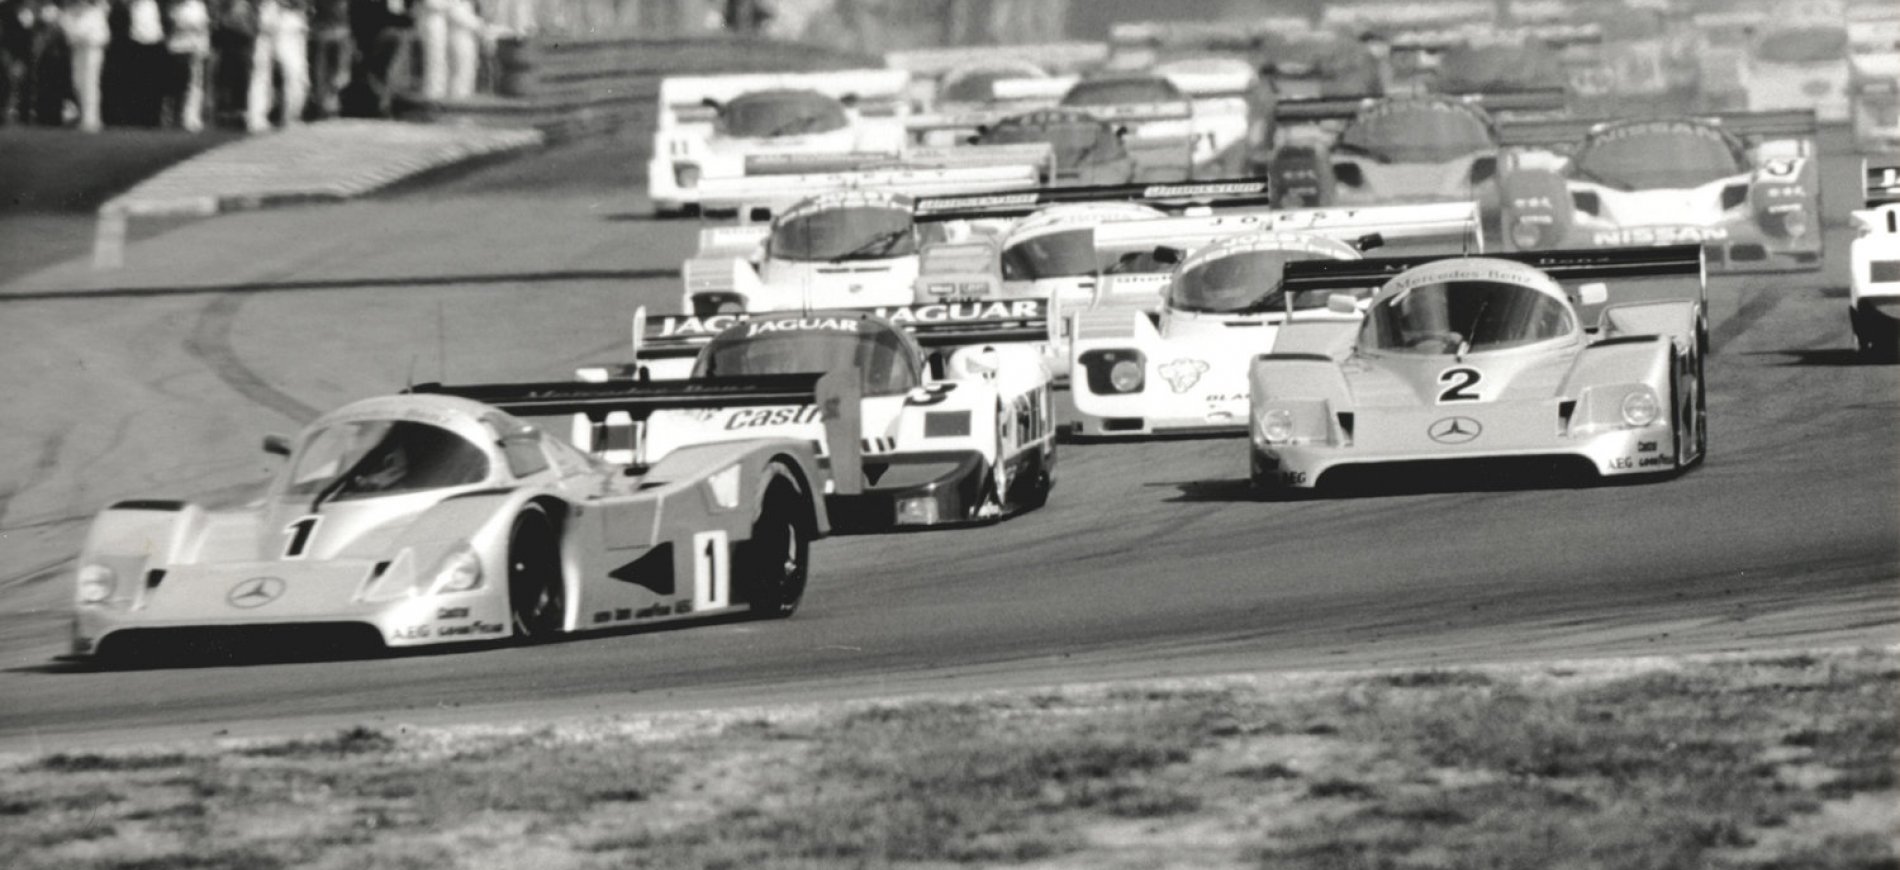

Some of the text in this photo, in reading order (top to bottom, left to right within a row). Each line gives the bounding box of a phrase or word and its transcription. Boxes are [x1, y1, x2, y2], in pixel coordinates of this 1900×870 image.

[1593, 225, 1729, 247] NISSAN
[659, 314, 750, 337] JAG
[746, 317, 858, 337] JAGUAR
[1439, 367, 1482, 402] 2
[724, 403, 823, 431] Castr
[286, 518, 319, 557] 1
[705, 538, 716, 603] 1
[391, 623, 431, 640] AEG
